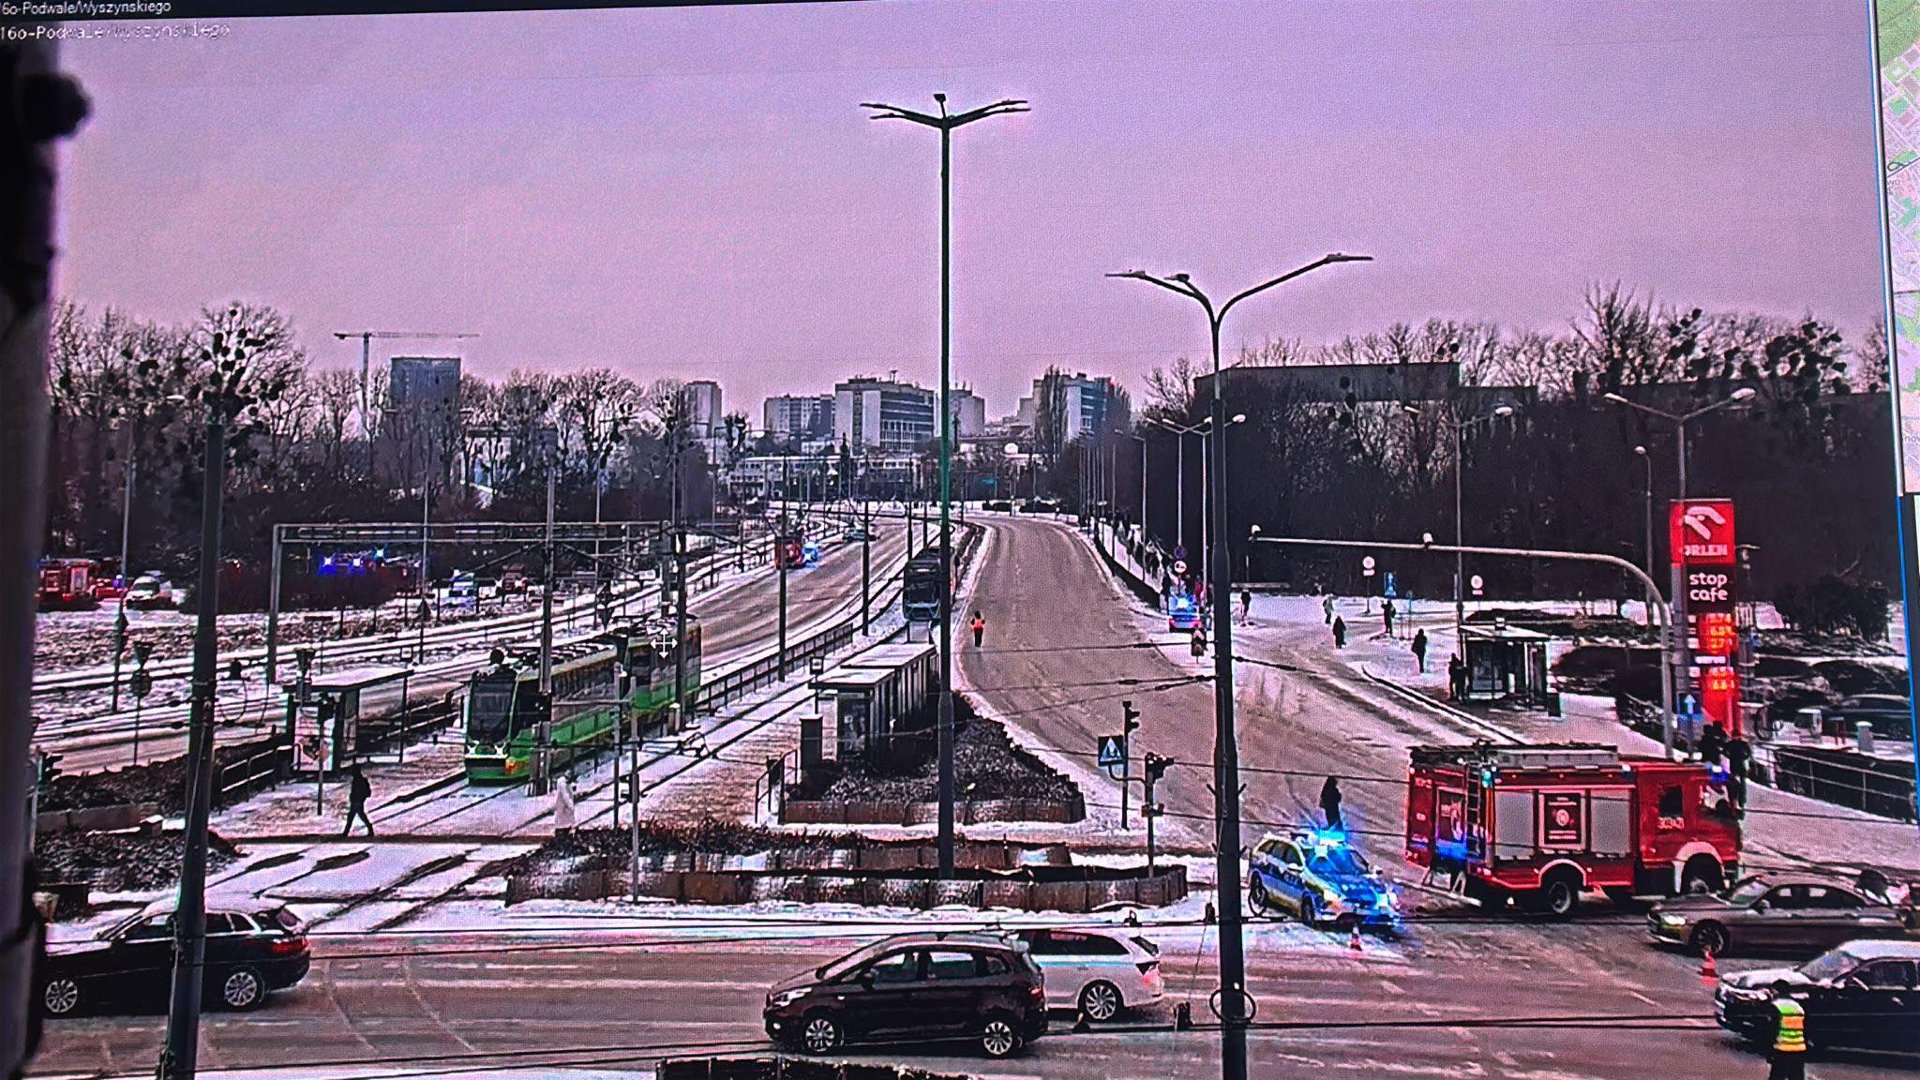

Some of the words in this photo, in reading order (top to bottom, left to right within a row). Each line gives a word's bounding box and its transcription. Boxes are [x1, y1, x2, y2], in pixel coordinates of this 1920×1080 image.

[0, 0, 172, 16] 6o-Podwale/Wyszynskiego
[1689, 572, 1728, 588] stop
[1690, 587, 1728, 602] cafe
